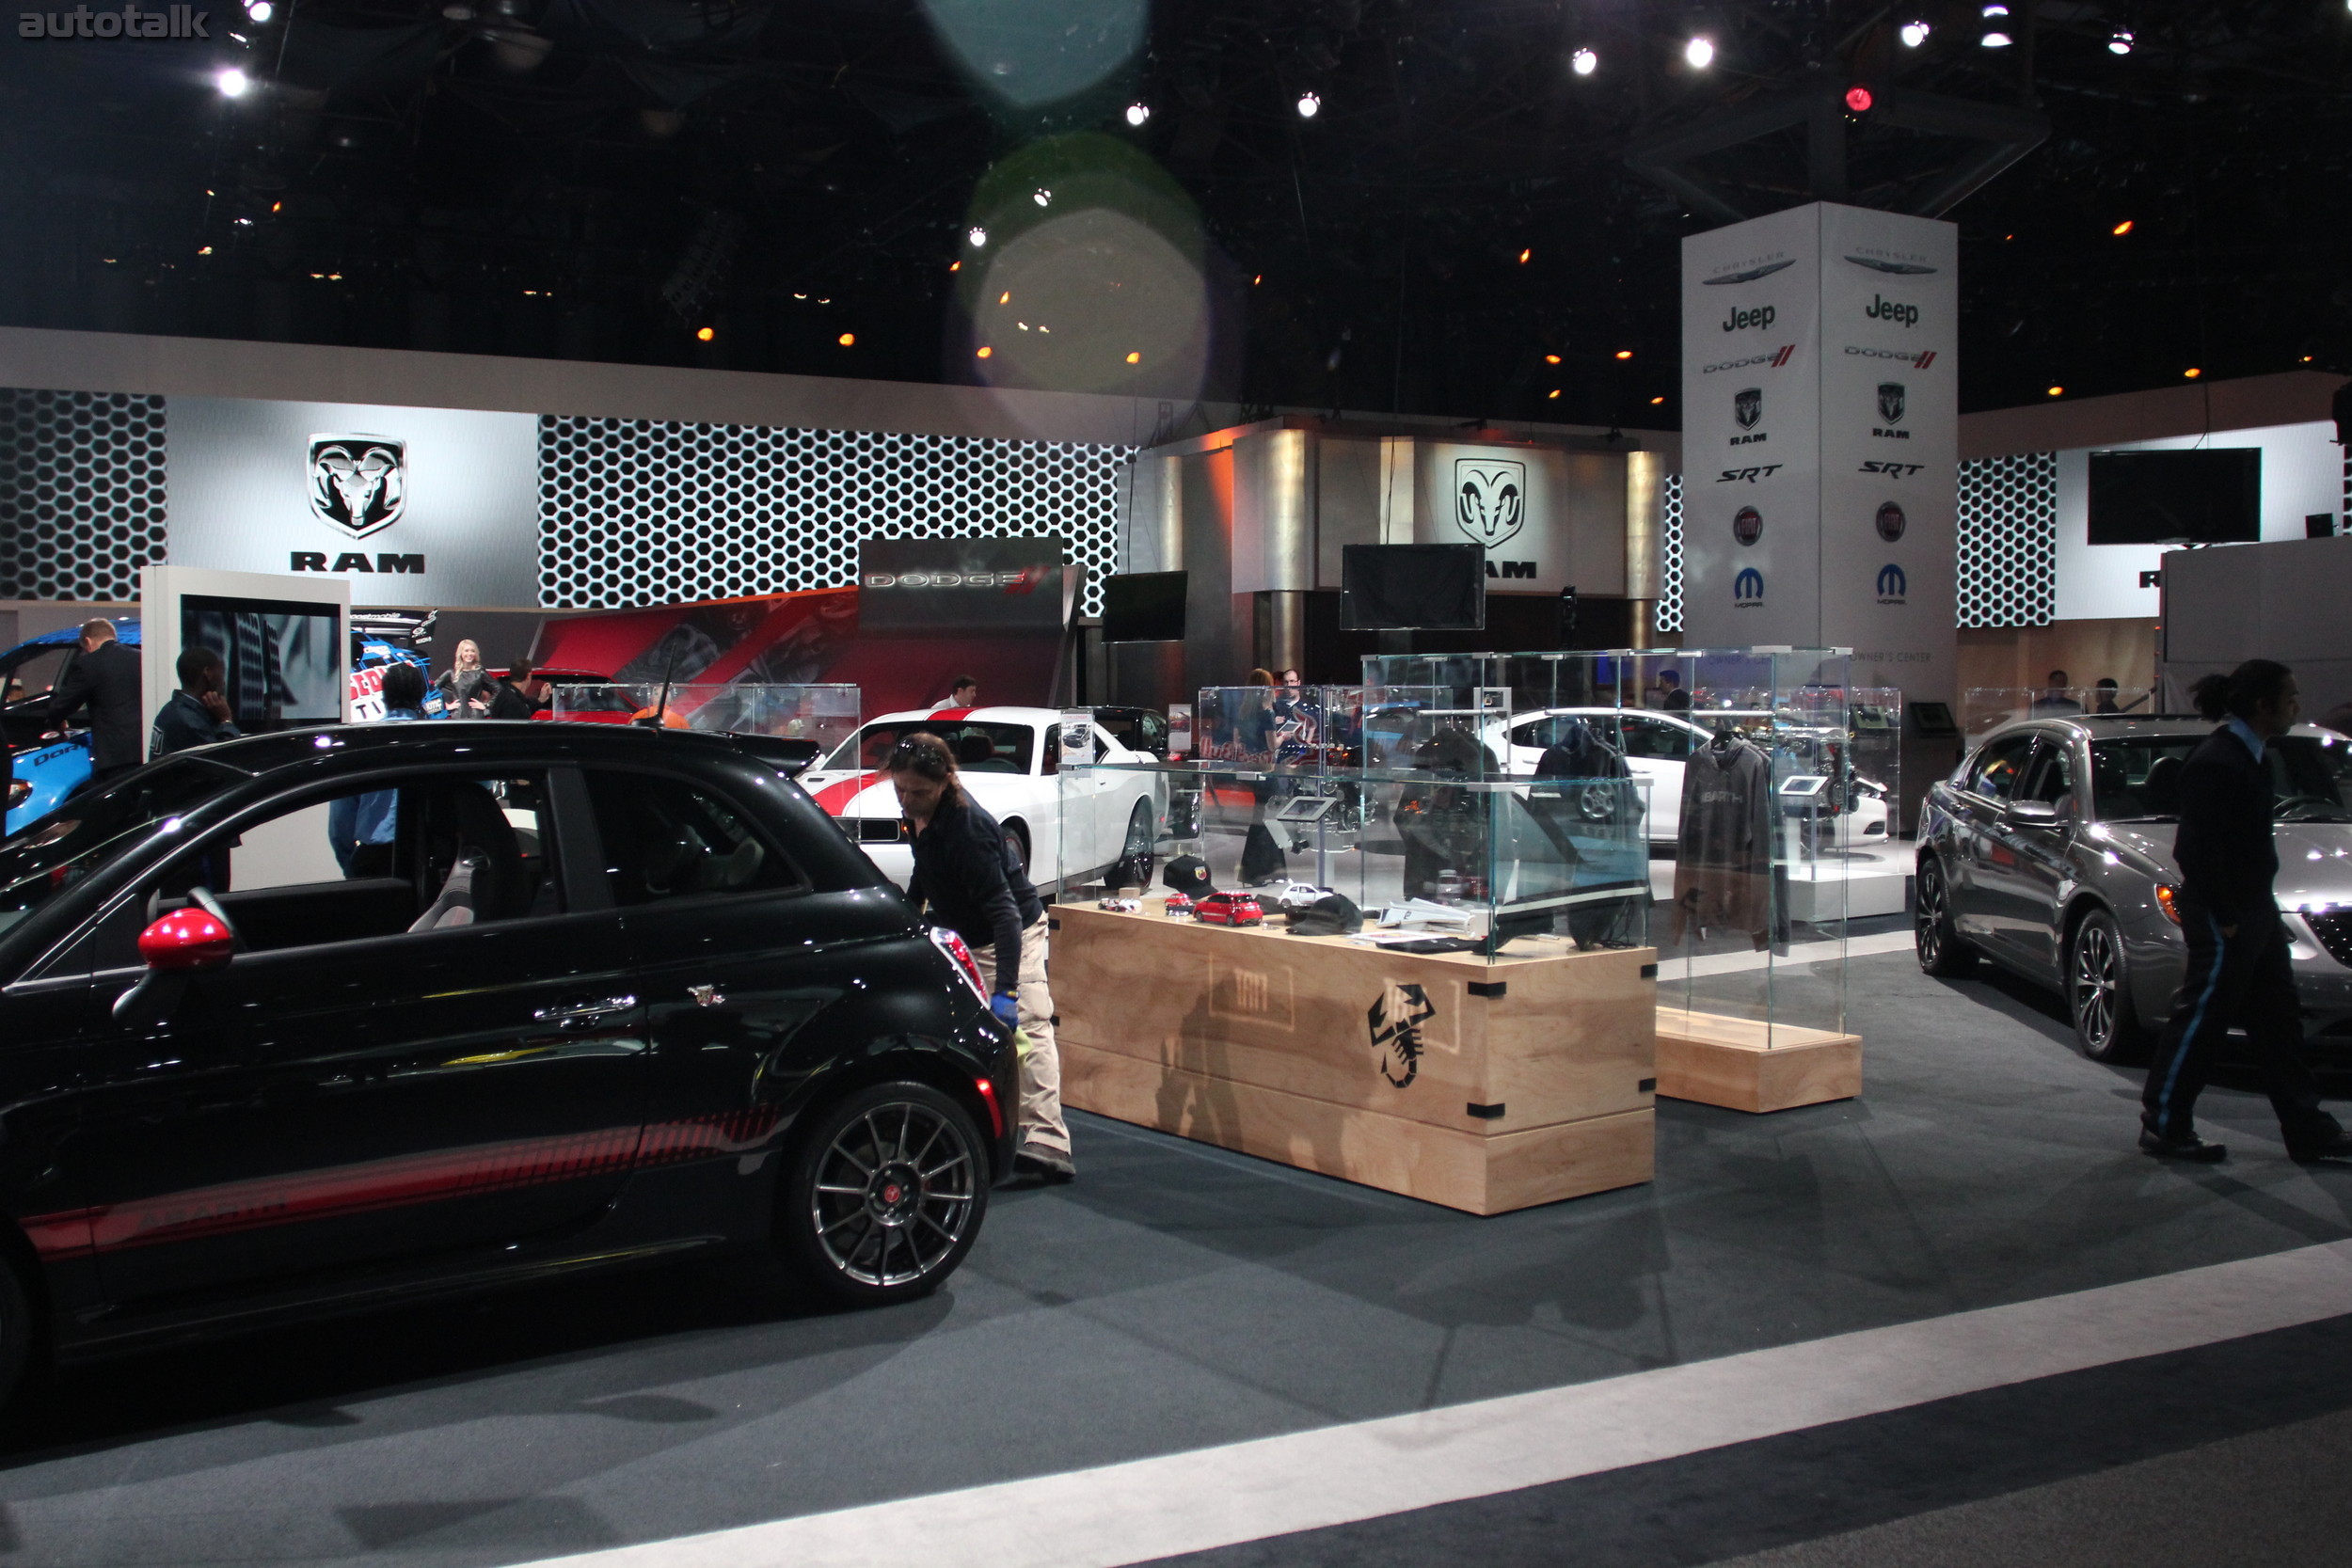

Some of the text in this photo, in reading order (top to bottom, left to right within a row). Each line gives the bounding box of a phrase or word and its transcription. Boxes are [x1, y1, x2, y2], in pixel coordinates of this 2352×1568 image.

[1712, 251, 1784, 274] CHRYSLER
[1855, 246, 1927, 262] CHRYSLER
[1723, 305, 1776, 332] Jeep
[1866, 293, 1918, 327] Jeep
[1703, 352, 1781, 373] DODGE
[1844, 345, 1924, 363] DODGE
[1729, 433, 1767, 446] RAM
[1872, 427, 1910, 439] RAM
[1716, 464, 1783, 483] SRT
[1858, 461, 1925, 479] SRT
[1741, 517, 1757, 535] FIAT
[291, 551, 425, 575] RAM
[864, 571, 1025, 588] DODGE
[1897, 653, 1931, 662] CENTER
[34, 744, 79, 767] Dar
